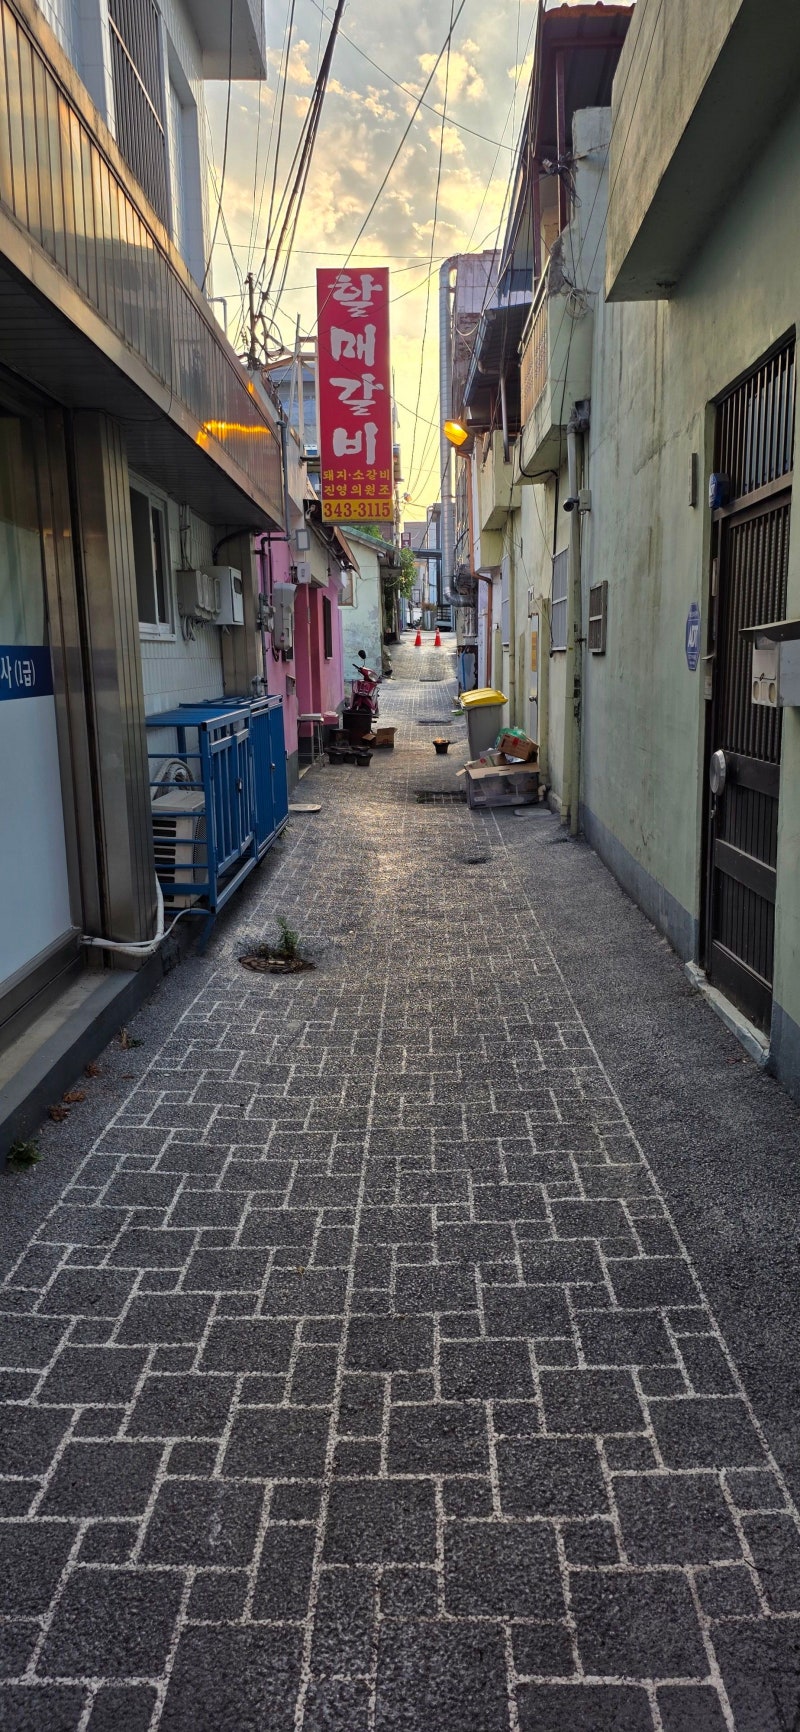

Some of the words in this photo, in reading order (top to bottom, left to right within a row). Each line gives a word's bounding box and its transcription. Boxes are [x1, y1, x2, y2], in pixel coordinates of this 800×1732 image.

[327, 273, 384, 466] 할매갈비
[324, 502, 391, 518] 343-3115
[687, 625, 699, 648] ADT
